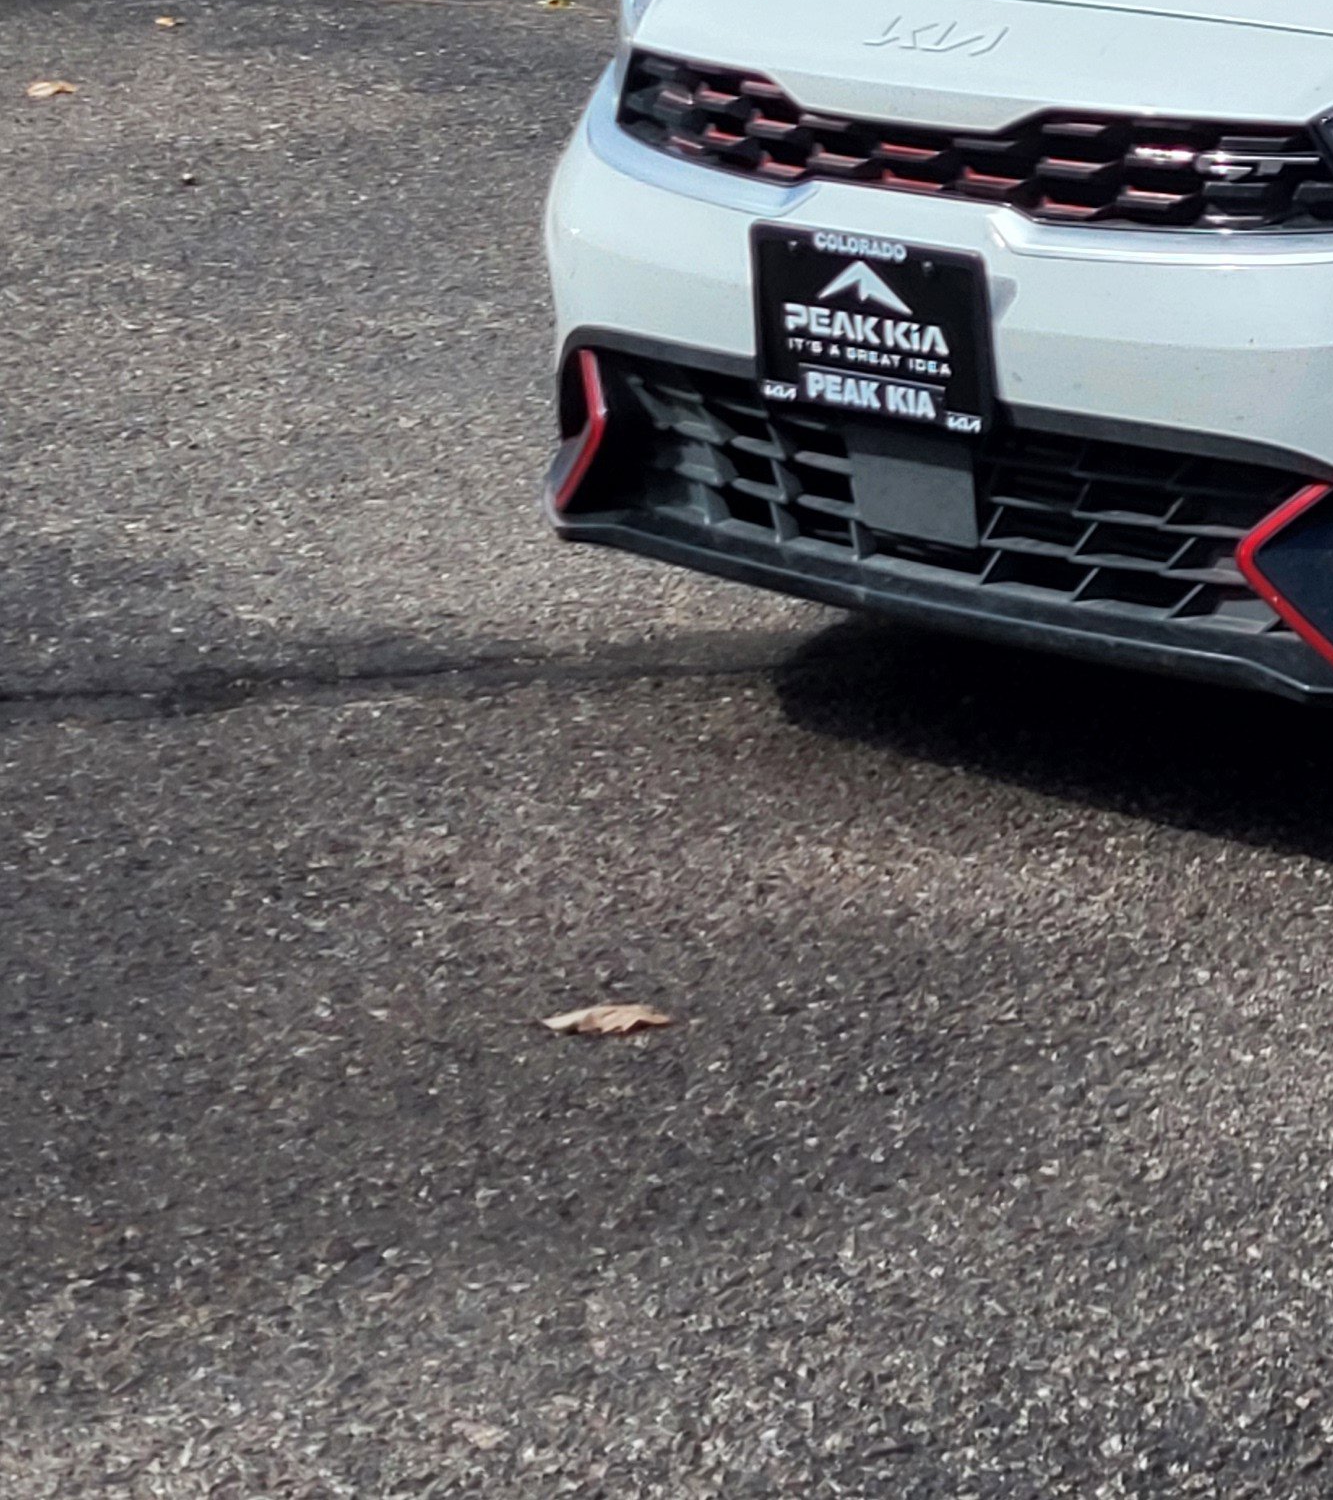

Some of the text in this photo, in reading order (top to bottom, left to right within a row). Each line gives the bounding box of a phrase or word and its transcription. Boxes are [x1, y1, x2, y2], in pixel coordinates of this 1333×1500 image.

[862, 15, 1010, 58] KIA
[1196, 151, 1321, 182] GT
[813, 231, 908, 262] COLORADO
[783, 302, 882, 346] PEAK
[788, 337, 952, 378] IT'S A GREAT IDEA
[805, 371, 882, 409] PEAK
[885, 384, 937, 420] KIA
